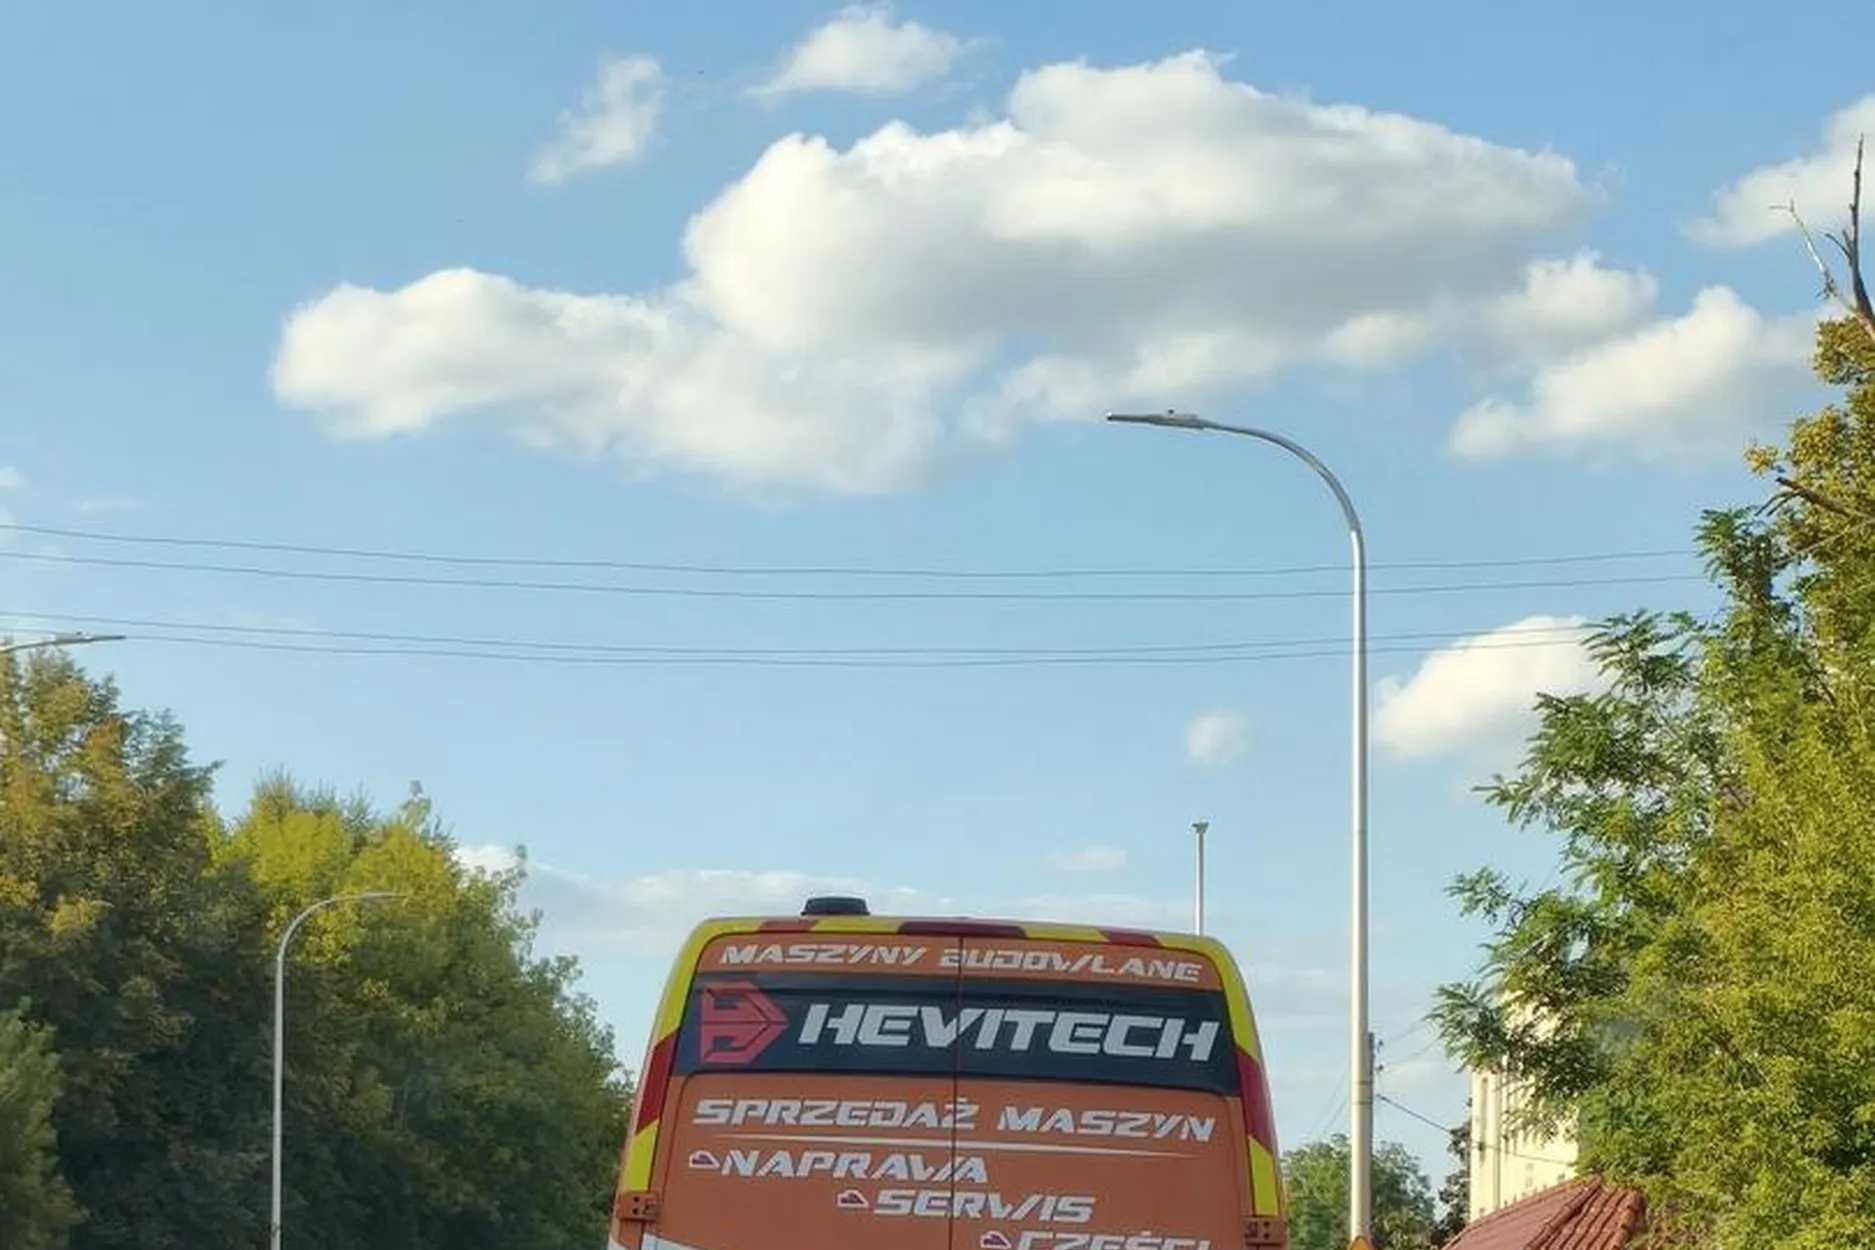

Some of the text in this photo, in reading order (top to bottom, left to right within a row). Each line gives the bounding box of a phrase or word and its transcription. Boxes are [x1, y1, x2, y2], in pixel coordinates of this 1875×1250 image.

[720, 944, 1203, 982] MASZYNY BUDOWLANE
[798, 1003, 1220, 1062] HEVITECH
[692, 1097, 1215, 1142] SPRZEDAŻ MASZYN
[721, 1150, 988, 1184] NAPRAWA
[873, 1189, 1097, 1223] SERWIS
